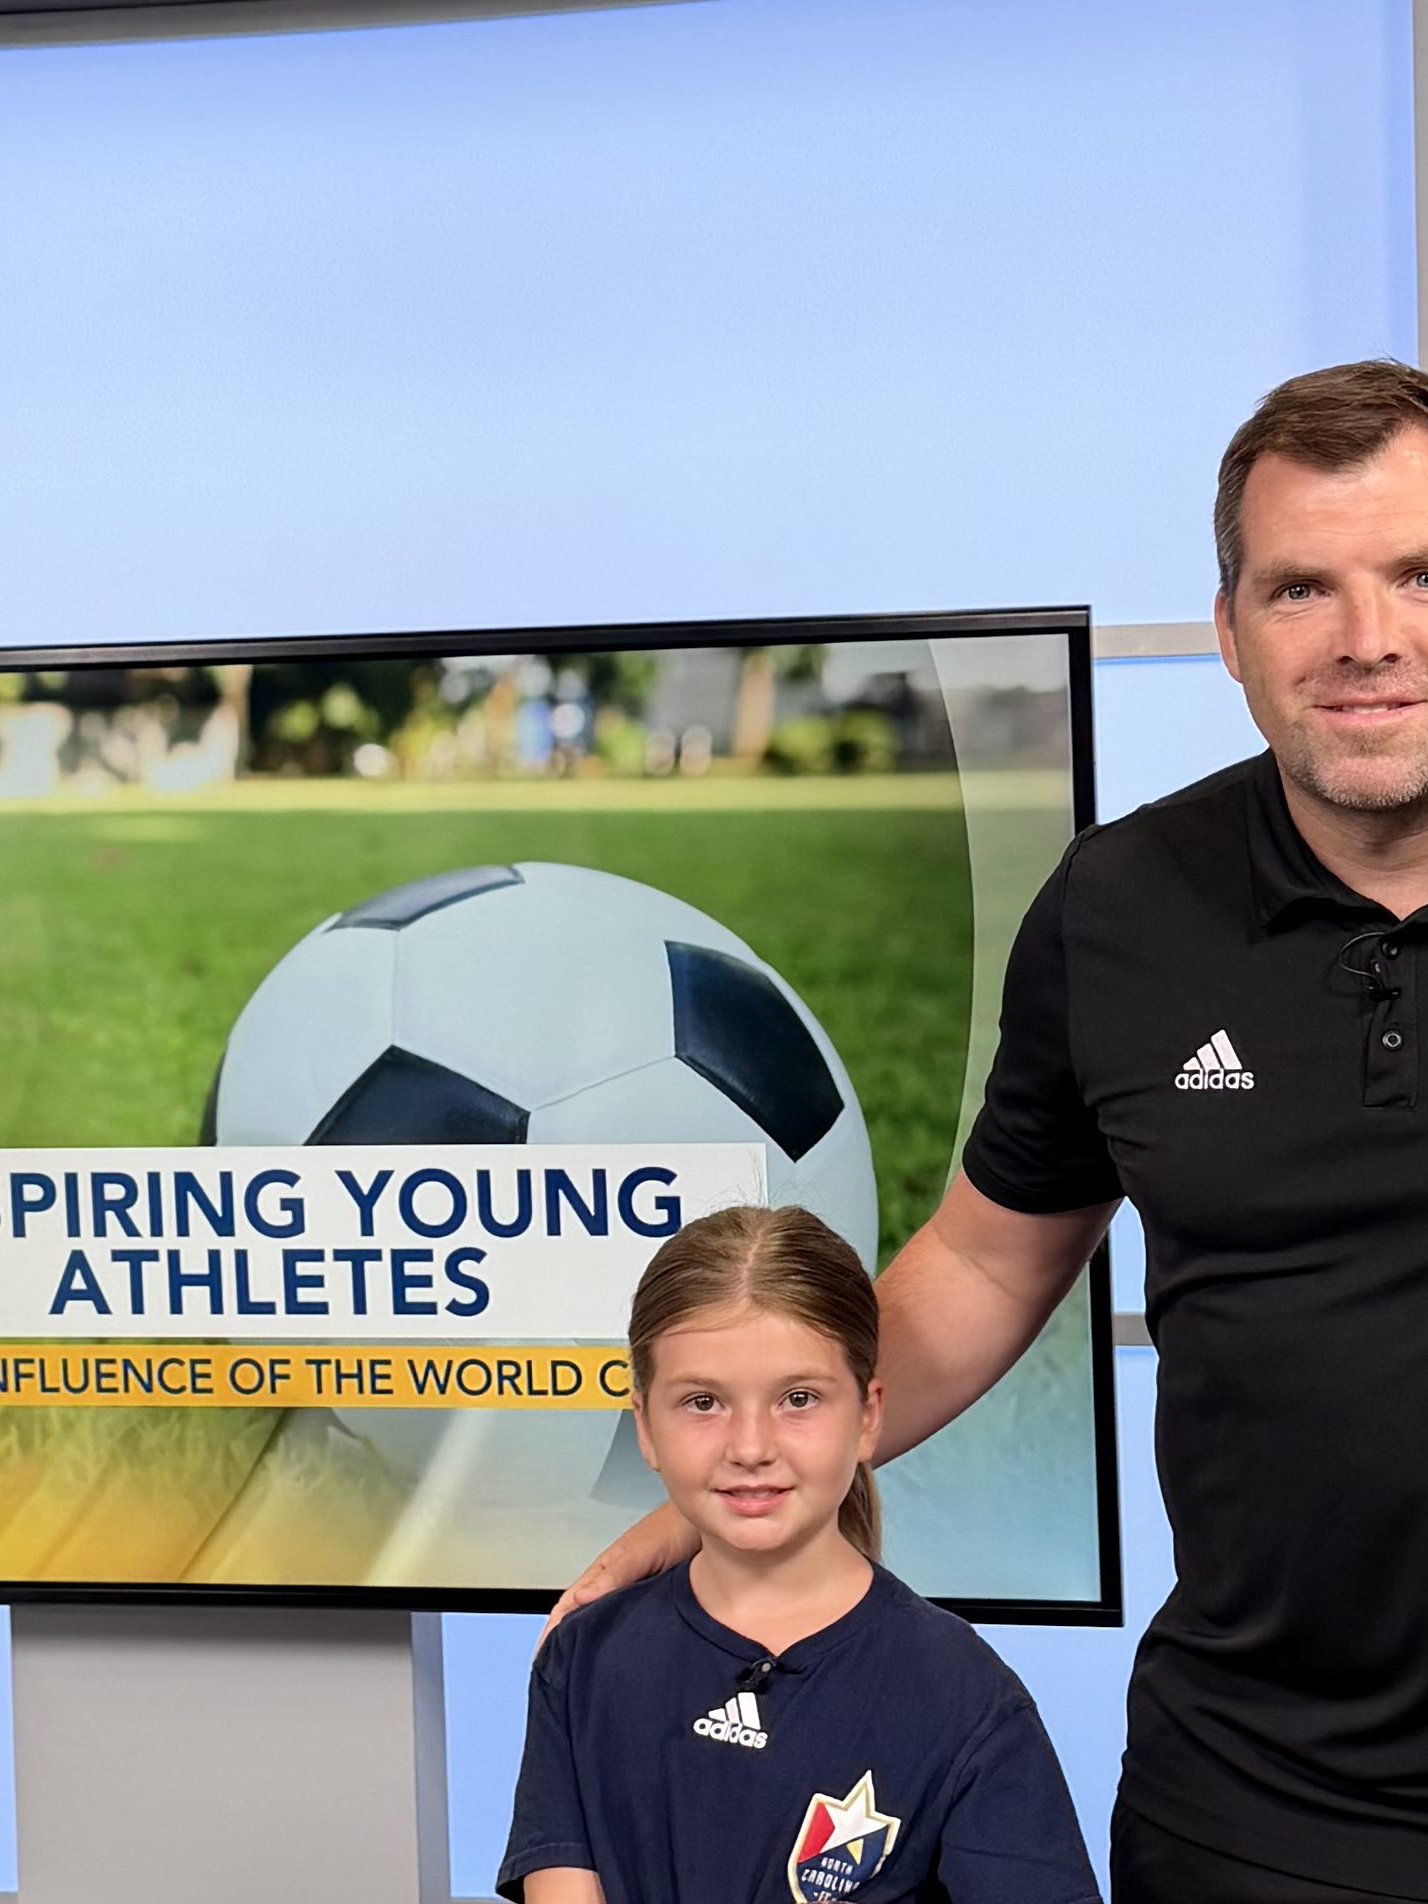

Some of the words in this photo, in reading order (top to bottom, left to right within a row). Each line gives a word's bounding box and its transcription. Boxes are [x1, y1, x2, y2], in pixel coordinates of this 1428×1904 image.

[1174, 1067, 1255, 1090] adidas
[334, 1166, 682, 1239] YOUNG
[48, 1246, 490, 1317] ATHLETES
[228, 1357, 291, 1395] OF
[304, 1359, 393, 1395] THE
[406, 1359, 583, 1396] WORLD
[693, 1718, 769, 1749] adidas
